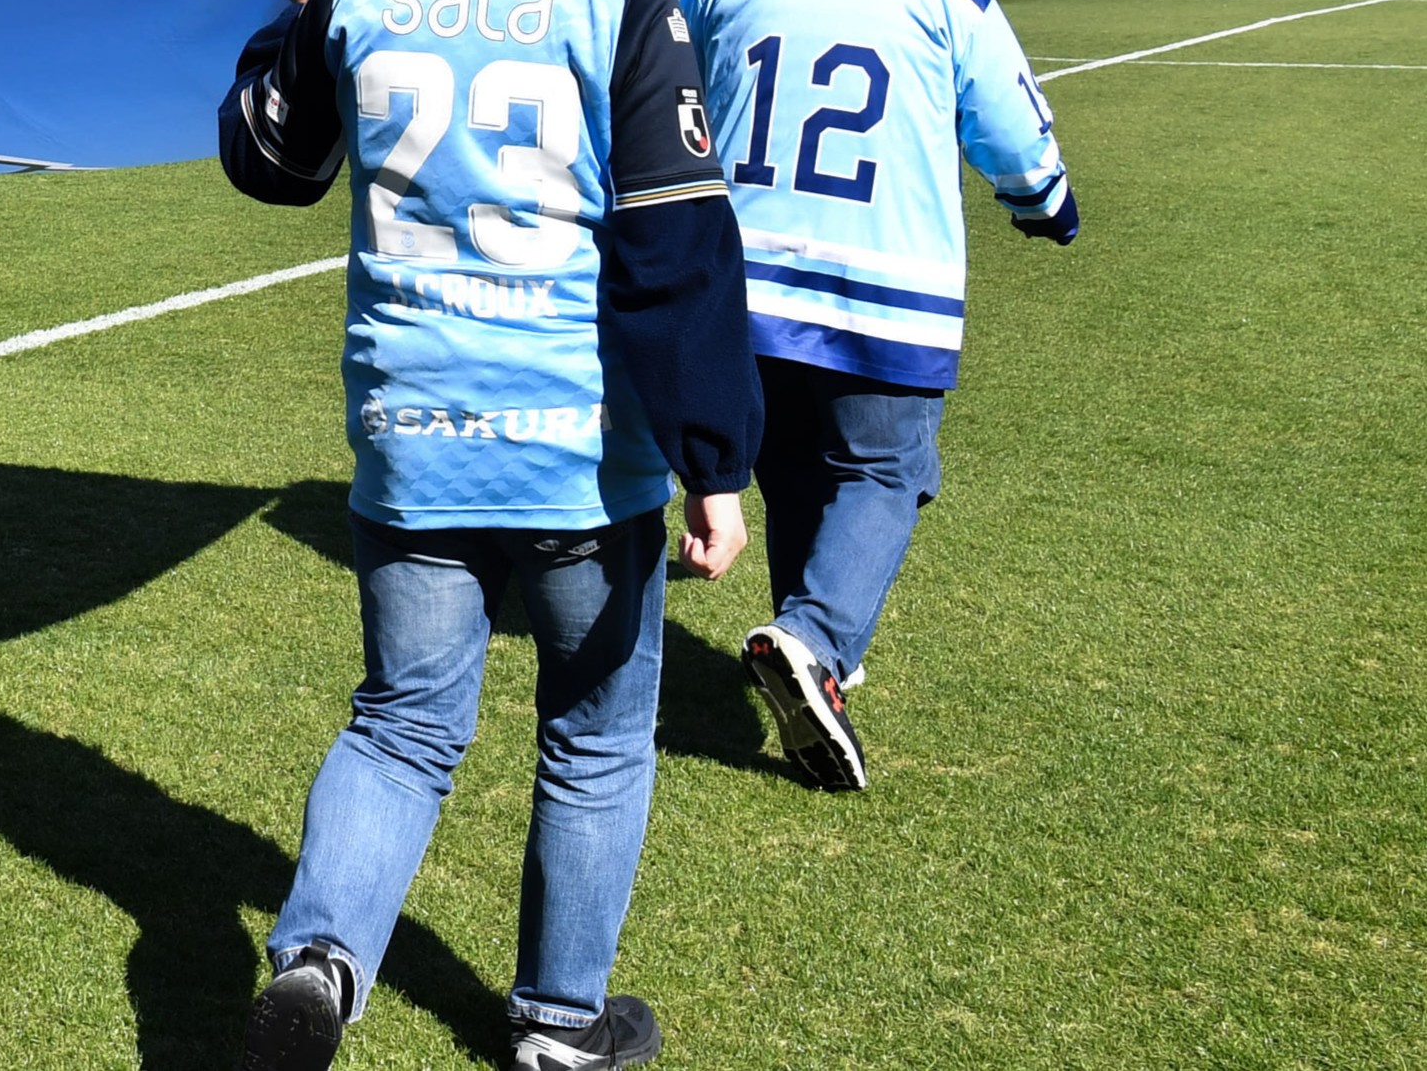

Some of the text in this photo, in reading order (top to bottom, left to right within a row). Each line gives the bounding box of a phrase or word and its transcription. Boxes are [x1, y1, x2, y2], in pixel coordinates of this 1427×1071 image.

[356, 49, 583, 268] 23
[733, 34, 890, 205] 12
[1018, 72, 1052, 136] 1
[394, 403, 613, 442] SAKURA
